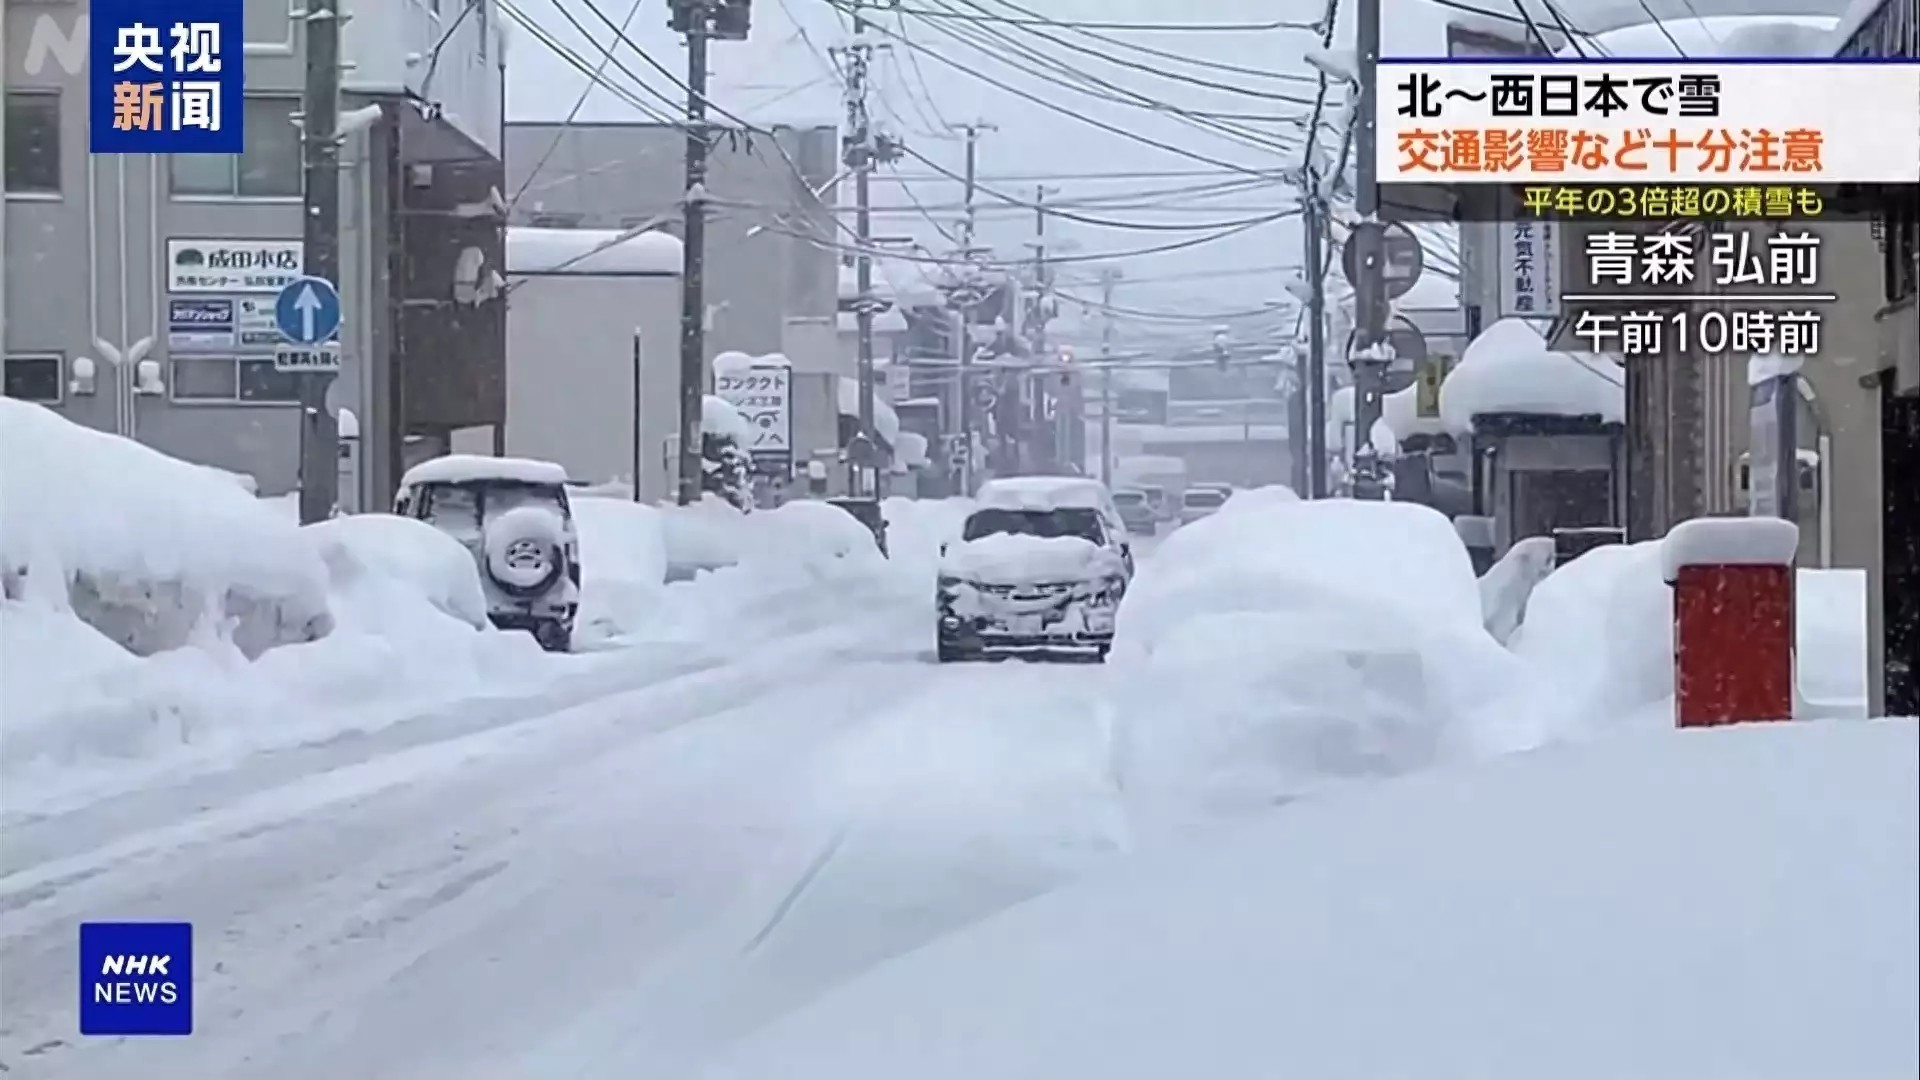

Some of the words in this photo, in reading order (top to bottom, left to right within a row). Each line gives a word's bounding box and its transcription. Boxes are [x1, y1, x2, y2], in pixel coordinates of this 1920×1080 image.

[208, 249, 298, 270] 成田本店
[719, 376, 785, 391] コンタクト
